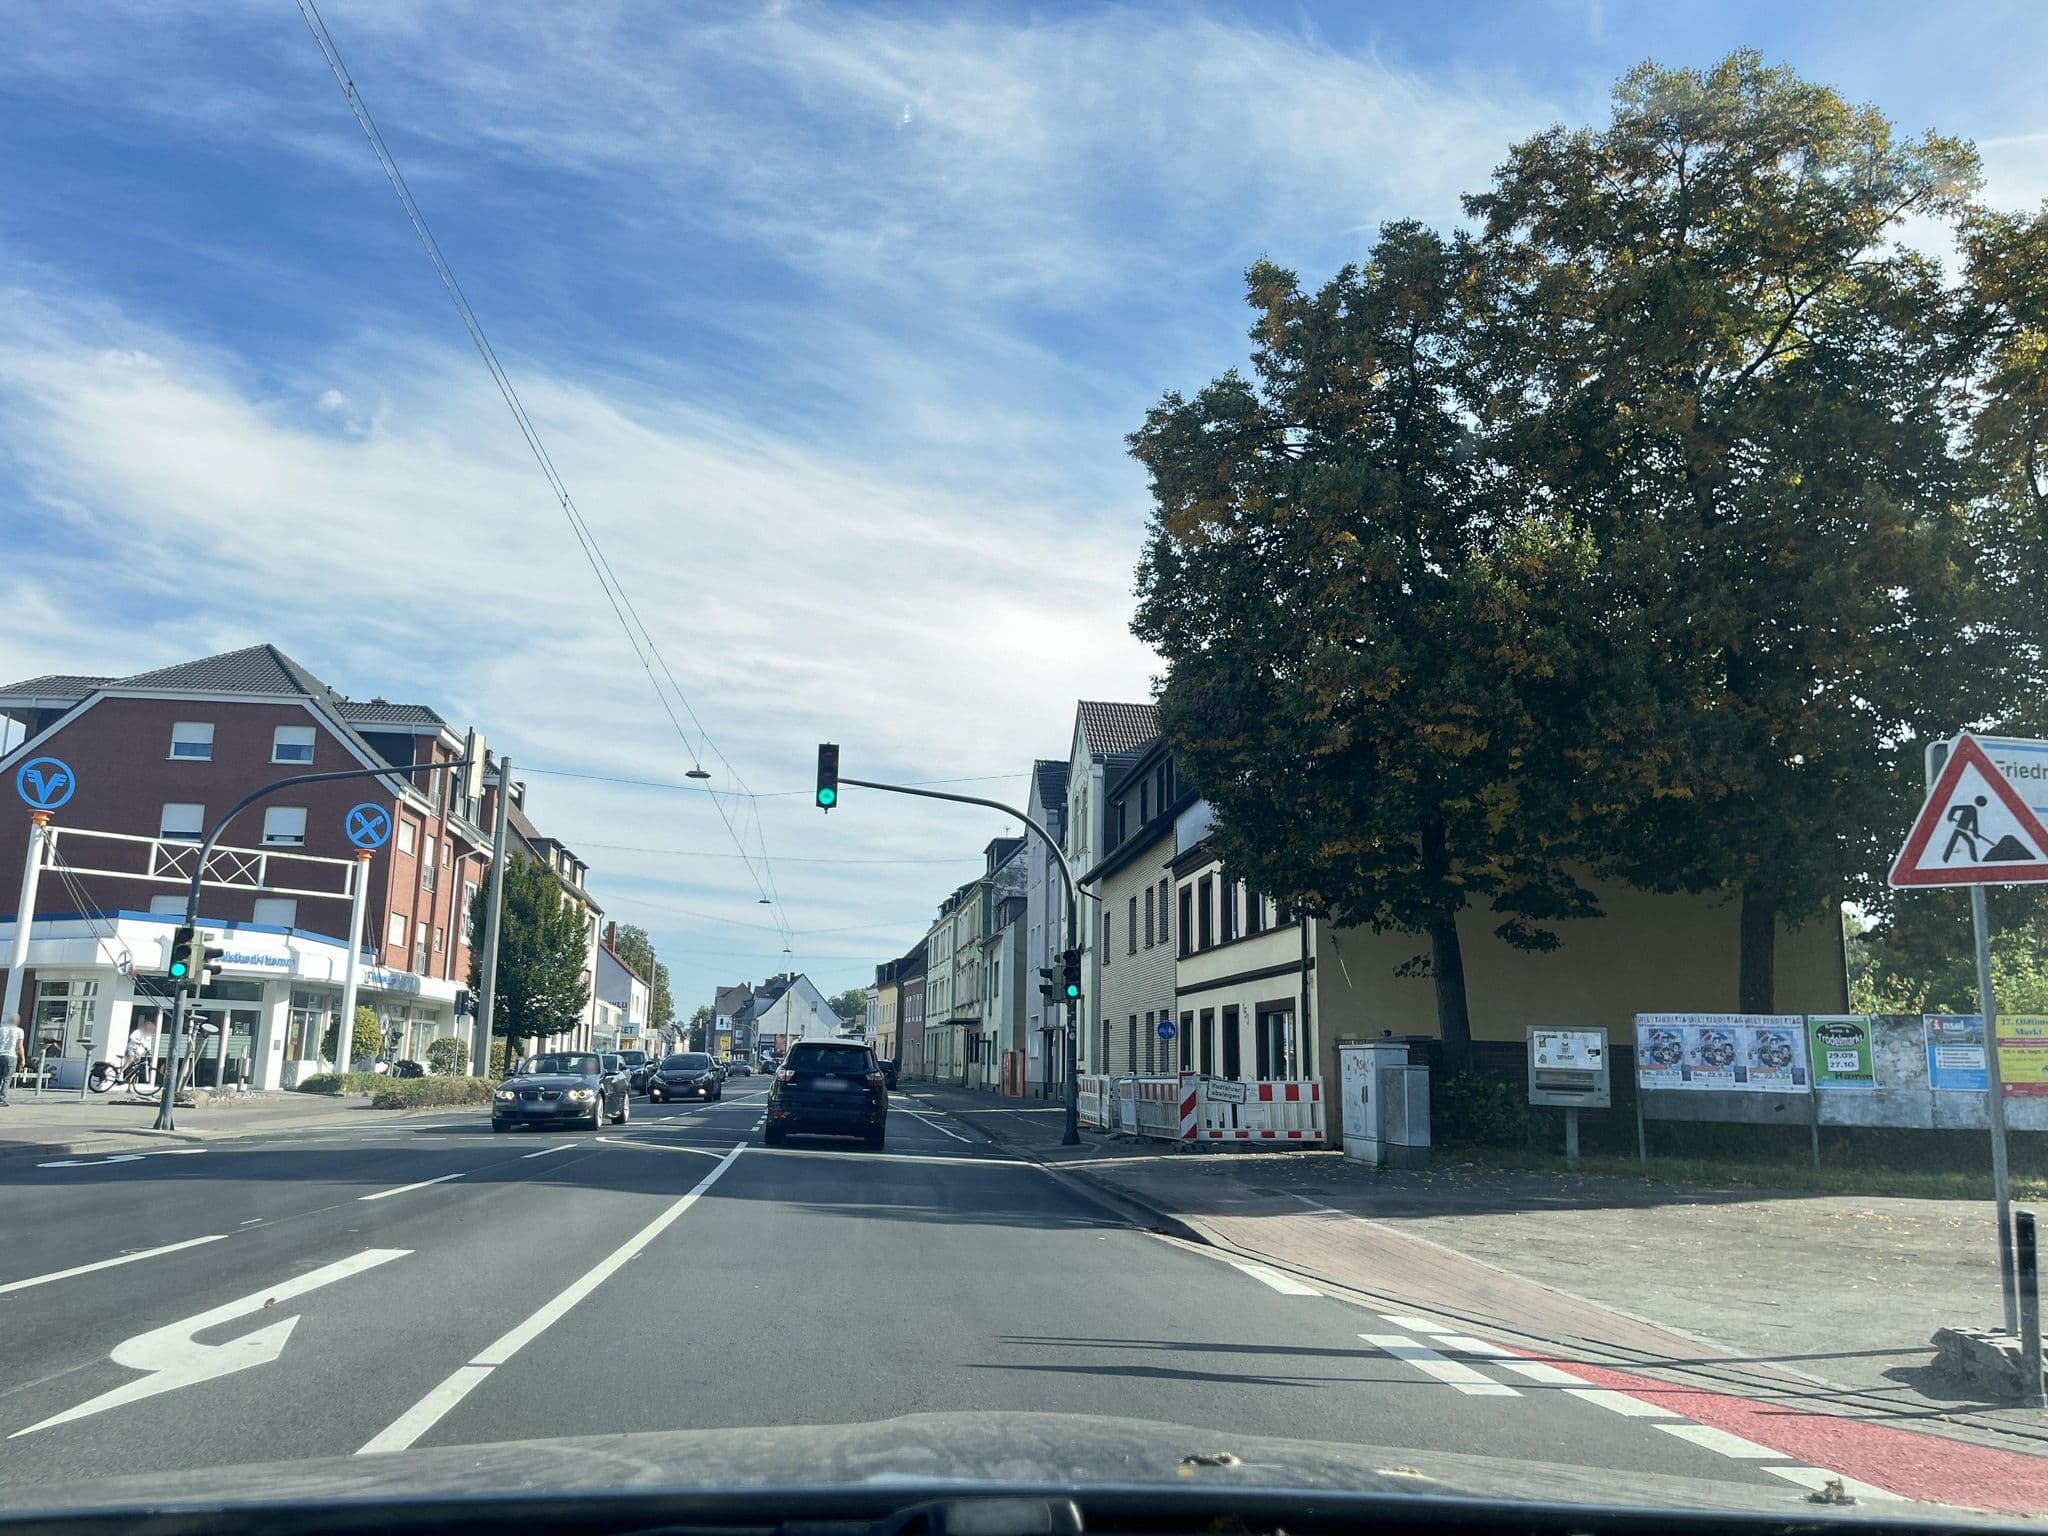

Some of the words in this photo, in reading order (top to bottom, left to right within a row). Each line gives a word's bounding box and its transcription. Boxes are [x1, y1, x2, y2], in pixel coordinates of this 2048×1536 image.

[1817, 1032, 1863, 1047] Trödelmarkt
[1828, 1052, 1857, 1060] 29.09.
[1829, 1061, 1858, 1069] 27.10.
